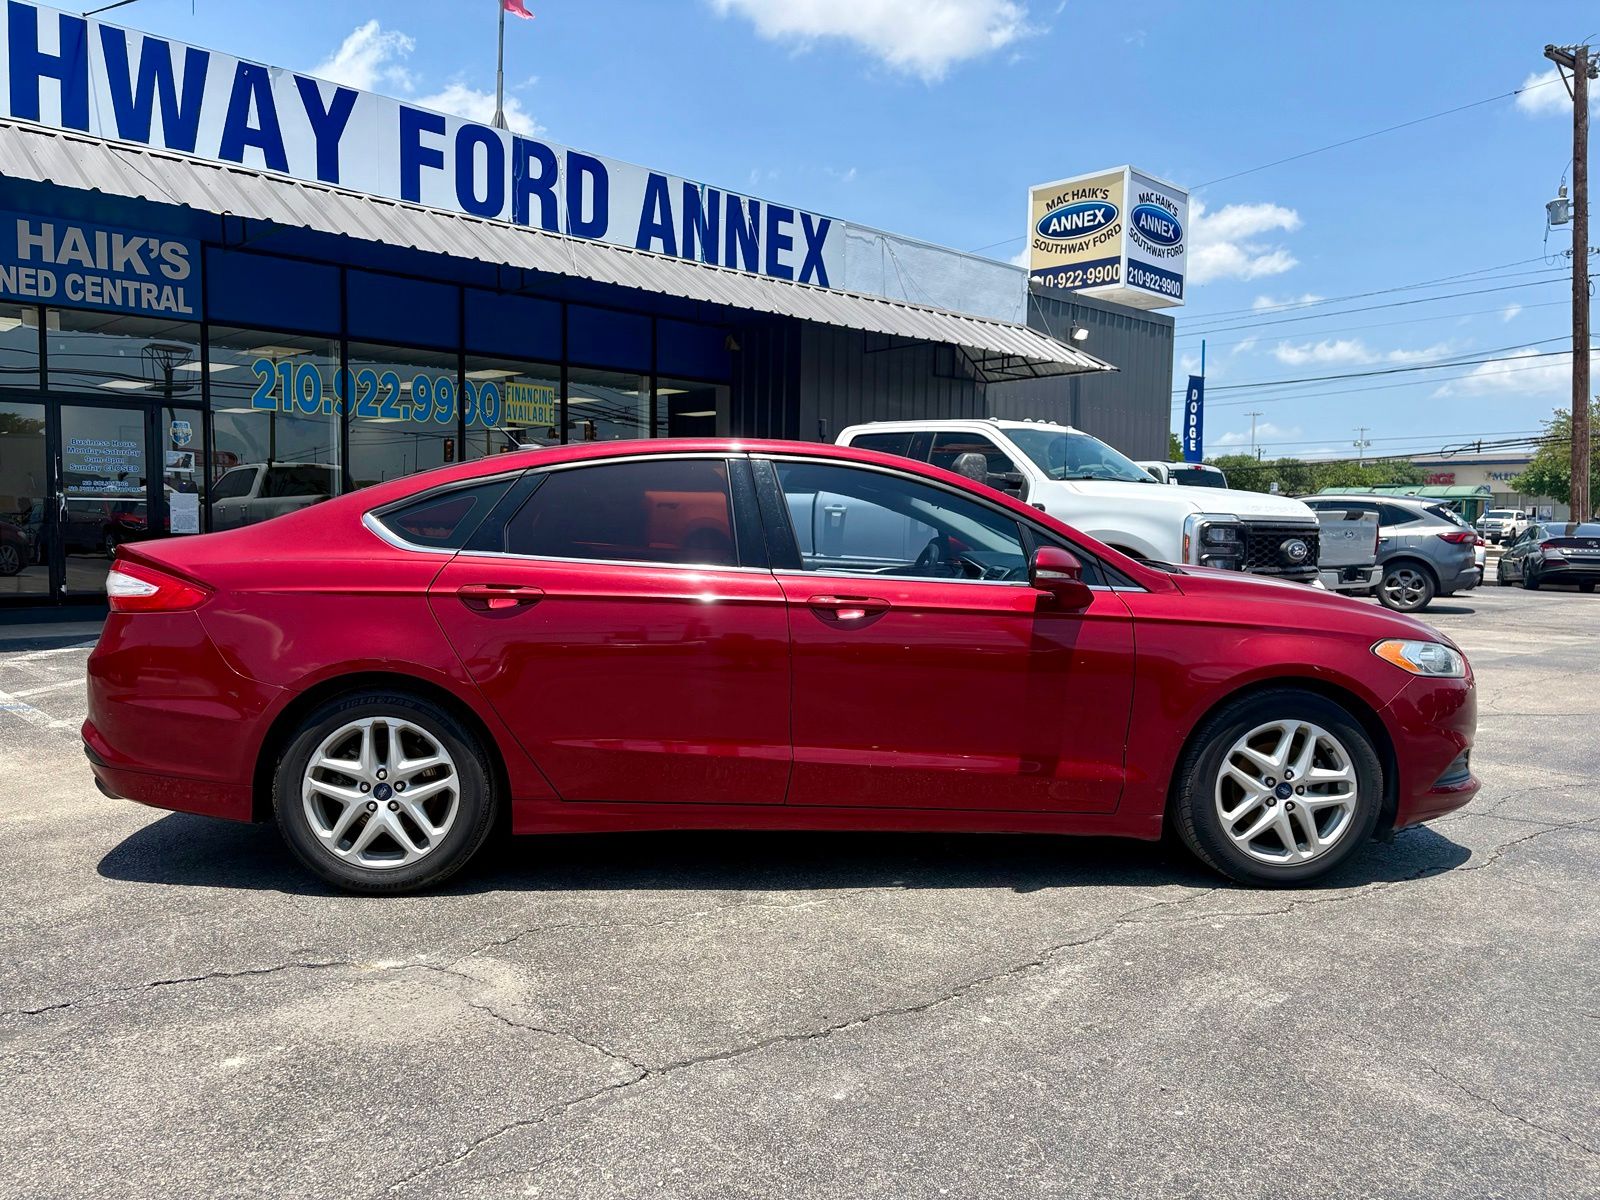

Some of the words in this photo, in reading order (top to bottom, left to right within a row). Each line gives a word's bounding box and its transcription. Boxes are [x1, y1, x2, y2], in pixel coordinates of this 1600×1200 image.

[7, 2, 359, 185] HWAY
[399, 105, 609, 240] FORD
[635, 172, 832, 288] ANNEX
[1045, 192, 1069, 211] MAC
[1071, 187, 1110, 201] HAIK'S
[1138, 192, 1154, 204] MAC
[1155, 195, 1179, 217] HAIK'S
[1048, 207, 1106, 234] ANNEX
[1139, 212, 1175, 240] ANNEX
[16, 218, 191, 281] HAIK'S
[1032, 238, 1091, 254] SOUTHWAY
[1092, 223, 1122, 247] FORD
[1128, 227, 1166, 259] SOUTHWAY
[1166, 244, 1184, 259] FORD
[0, 264, 57, 298] NED
[64, 273, 193, 314] CENTRAL
[251, 358, 501, 428] 210.922.9900
[506, 385, 553, 406] FINANCING
[506, 404, 553, 424] AVAILABLE
[1189, 389, 1199, 452] DODGE
